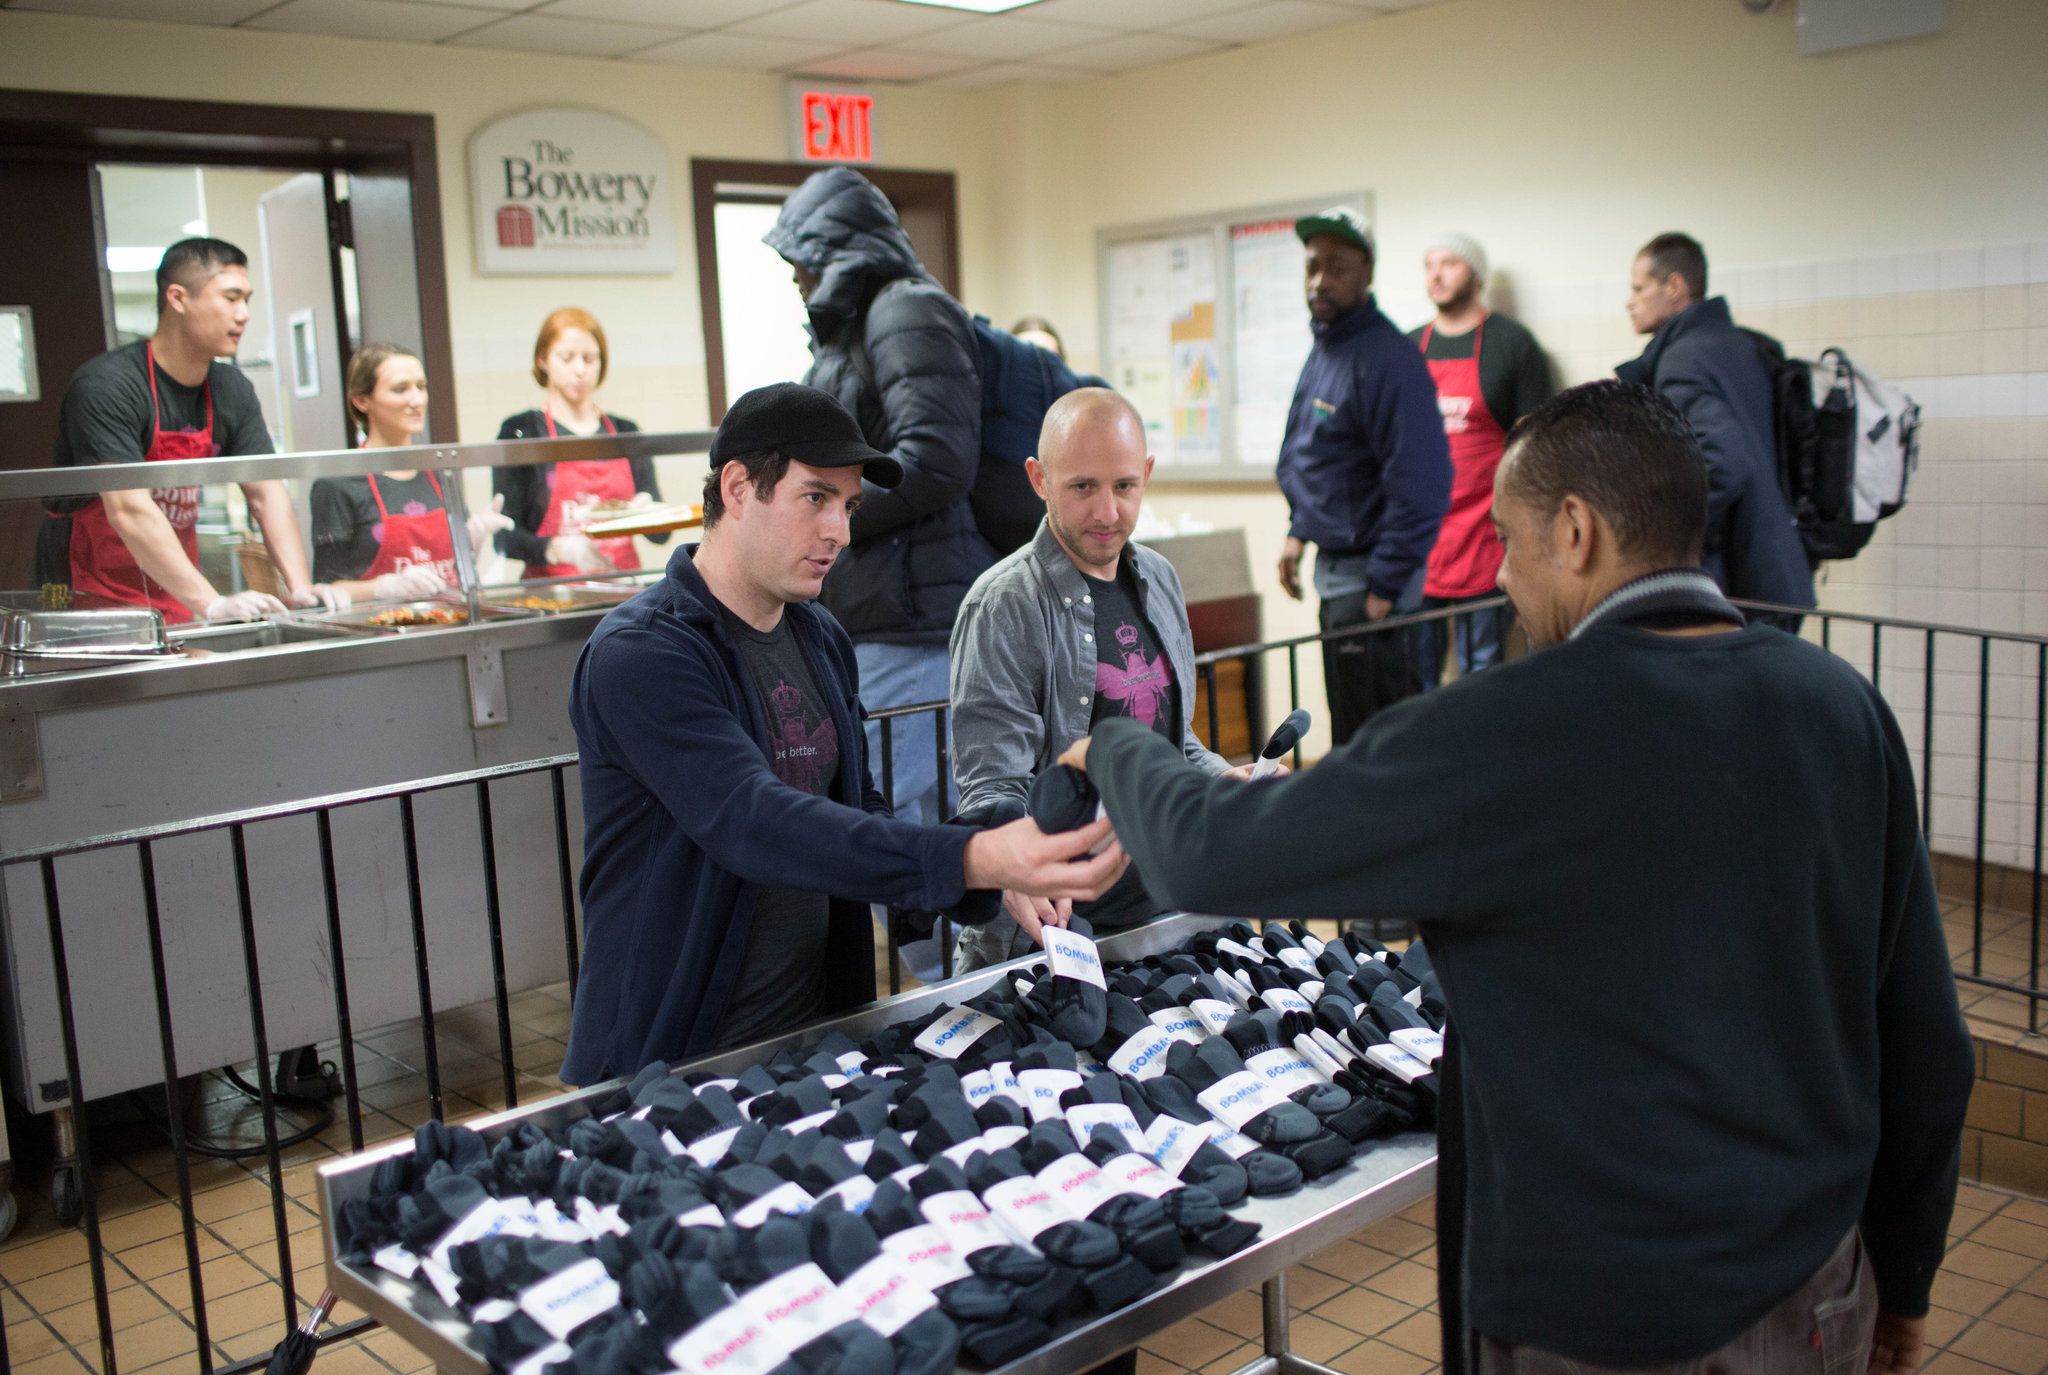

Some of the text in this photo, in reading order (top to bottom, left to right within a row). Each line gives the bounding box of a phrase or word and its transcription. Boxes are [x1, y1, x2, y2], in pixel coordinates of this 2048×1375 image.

[803, 92, 874, 161] EXIT
[530, 139, 574, 167] The
[502, 154, 657, 215] Bowery
[535, 204, 649, 239] Mission
[790, 745, 818, 758] better.
[1055, 943, 1100, 968] BOMBAS
[935, 1012, 981, 1046] BOMBAS
